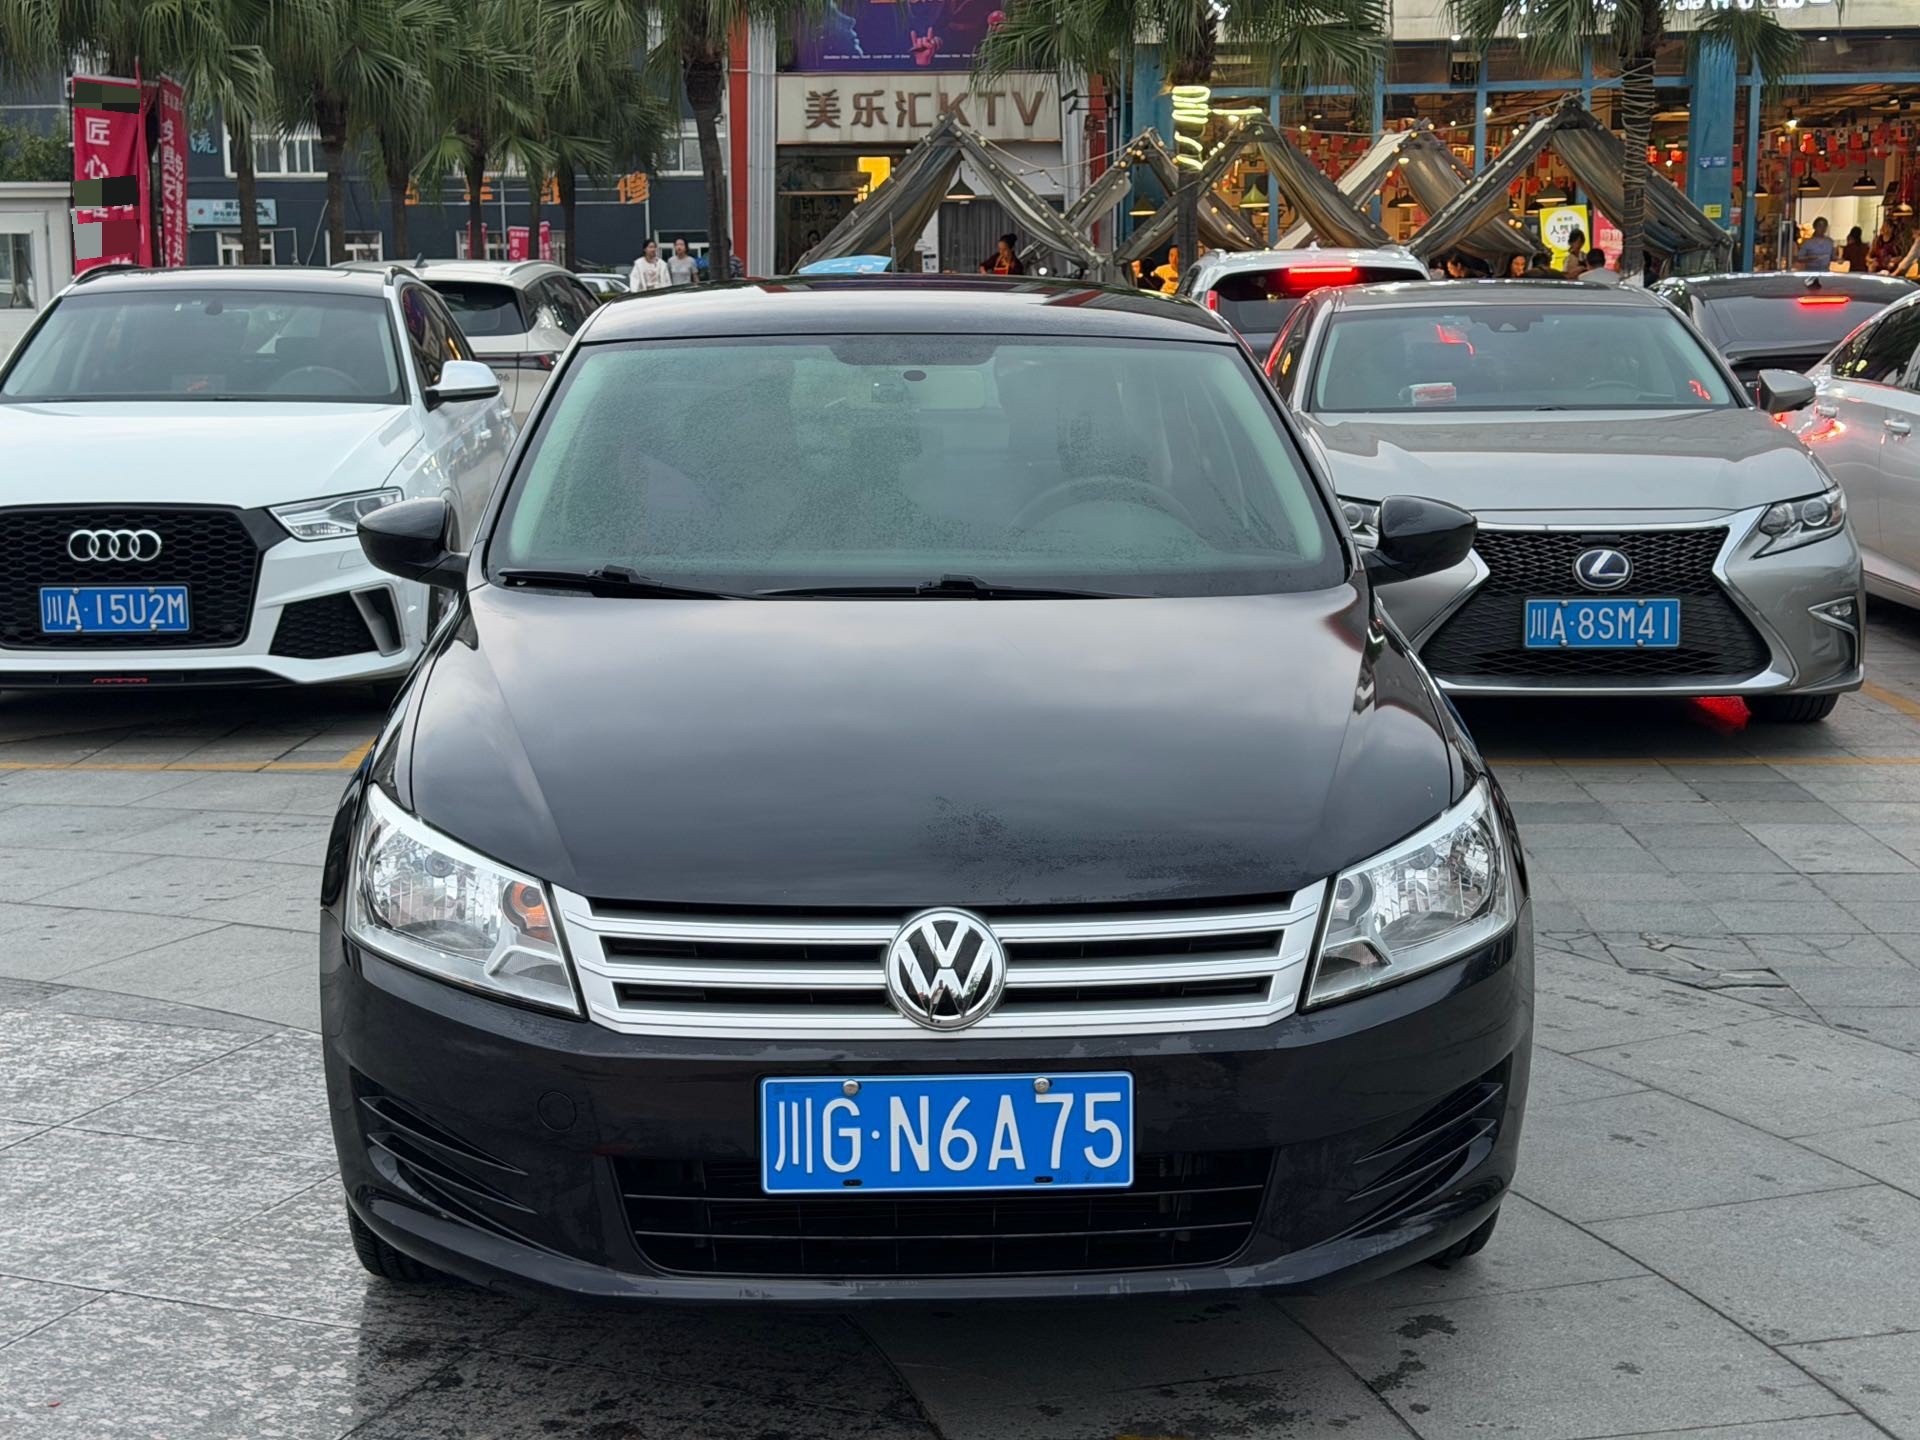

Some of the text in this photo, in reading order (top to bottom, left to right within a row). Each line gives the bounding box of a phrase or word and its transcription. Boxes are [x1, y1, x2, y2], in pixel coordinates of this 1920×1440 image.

[804, 88, 1045, 129] 美乐汇KTV
[46, 593, 186, 626] 川A·15U2M
[1529, 606, 1671, 641] 川A·8SM41
[774, 1091, 1124, 1174] 川G·N6A75
